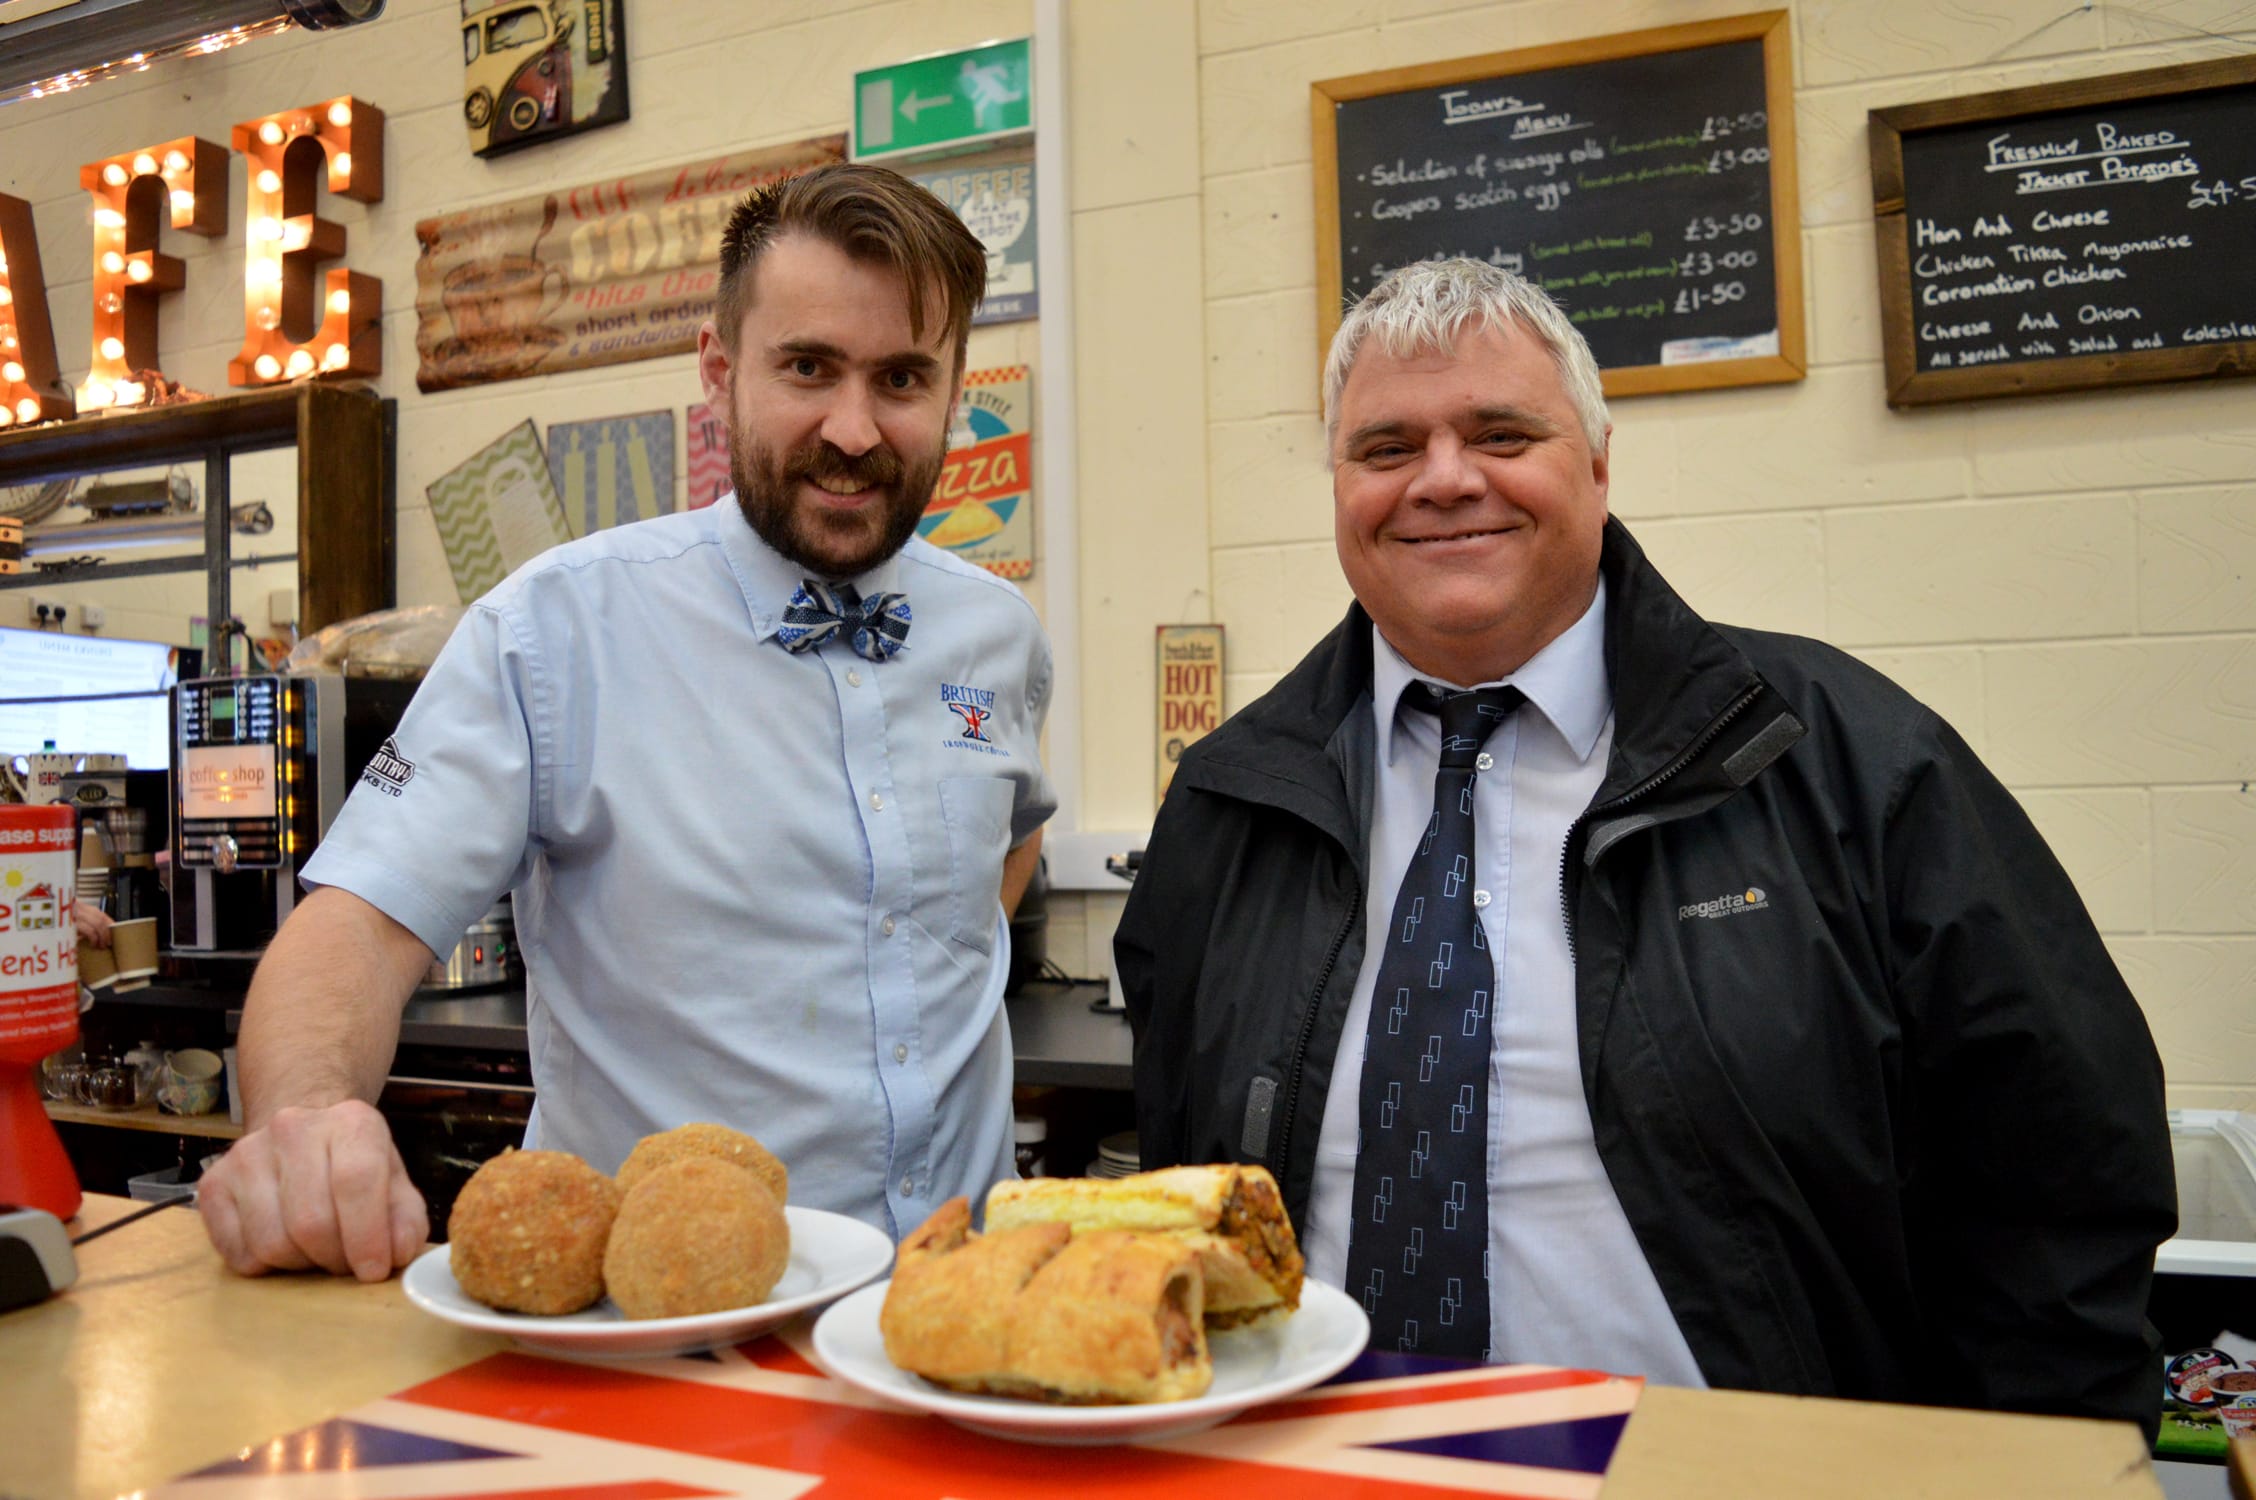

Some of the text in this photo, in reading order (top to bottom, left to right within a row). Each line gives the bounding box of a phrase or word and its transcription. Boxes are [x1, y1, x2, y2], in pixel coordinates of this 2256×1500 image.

[1987, 123, 2176, 165] FRESHLY BAKED
[1371, 157, 1457, 186] Selection
[1465, 154, 1486, 178] of
[2017, 171, 2090, 193] JACKET
[914, 166, 1033, 208] OFFEE
[1524, 181, 1571, 211] eggs
[569, 195, 738, 282] COFF
[1973, 214, 2013, 238] And
[2032, 209, 2109, 231] Cheese
[1914, 254, 1995, 278] Chicken
[1923, 263, 2126, 306] Coronation Chicken
[575, 311, 638, 337] short
[1921, 304, 2141, 341] Cheese And Onion
[2132, 333, 2163, 348] and
[934, 450, 1019, 501] izza
[1164, 663, 1217, 696] HOT
[941, 682, 996, 710] BRITISH
[1163, 700, 1216, 732] DOG
[190, 763, 265, 786] coffe shop
[381, 782, 403, 798] LTD
[1678, 893, 1745, 921] Regatta
